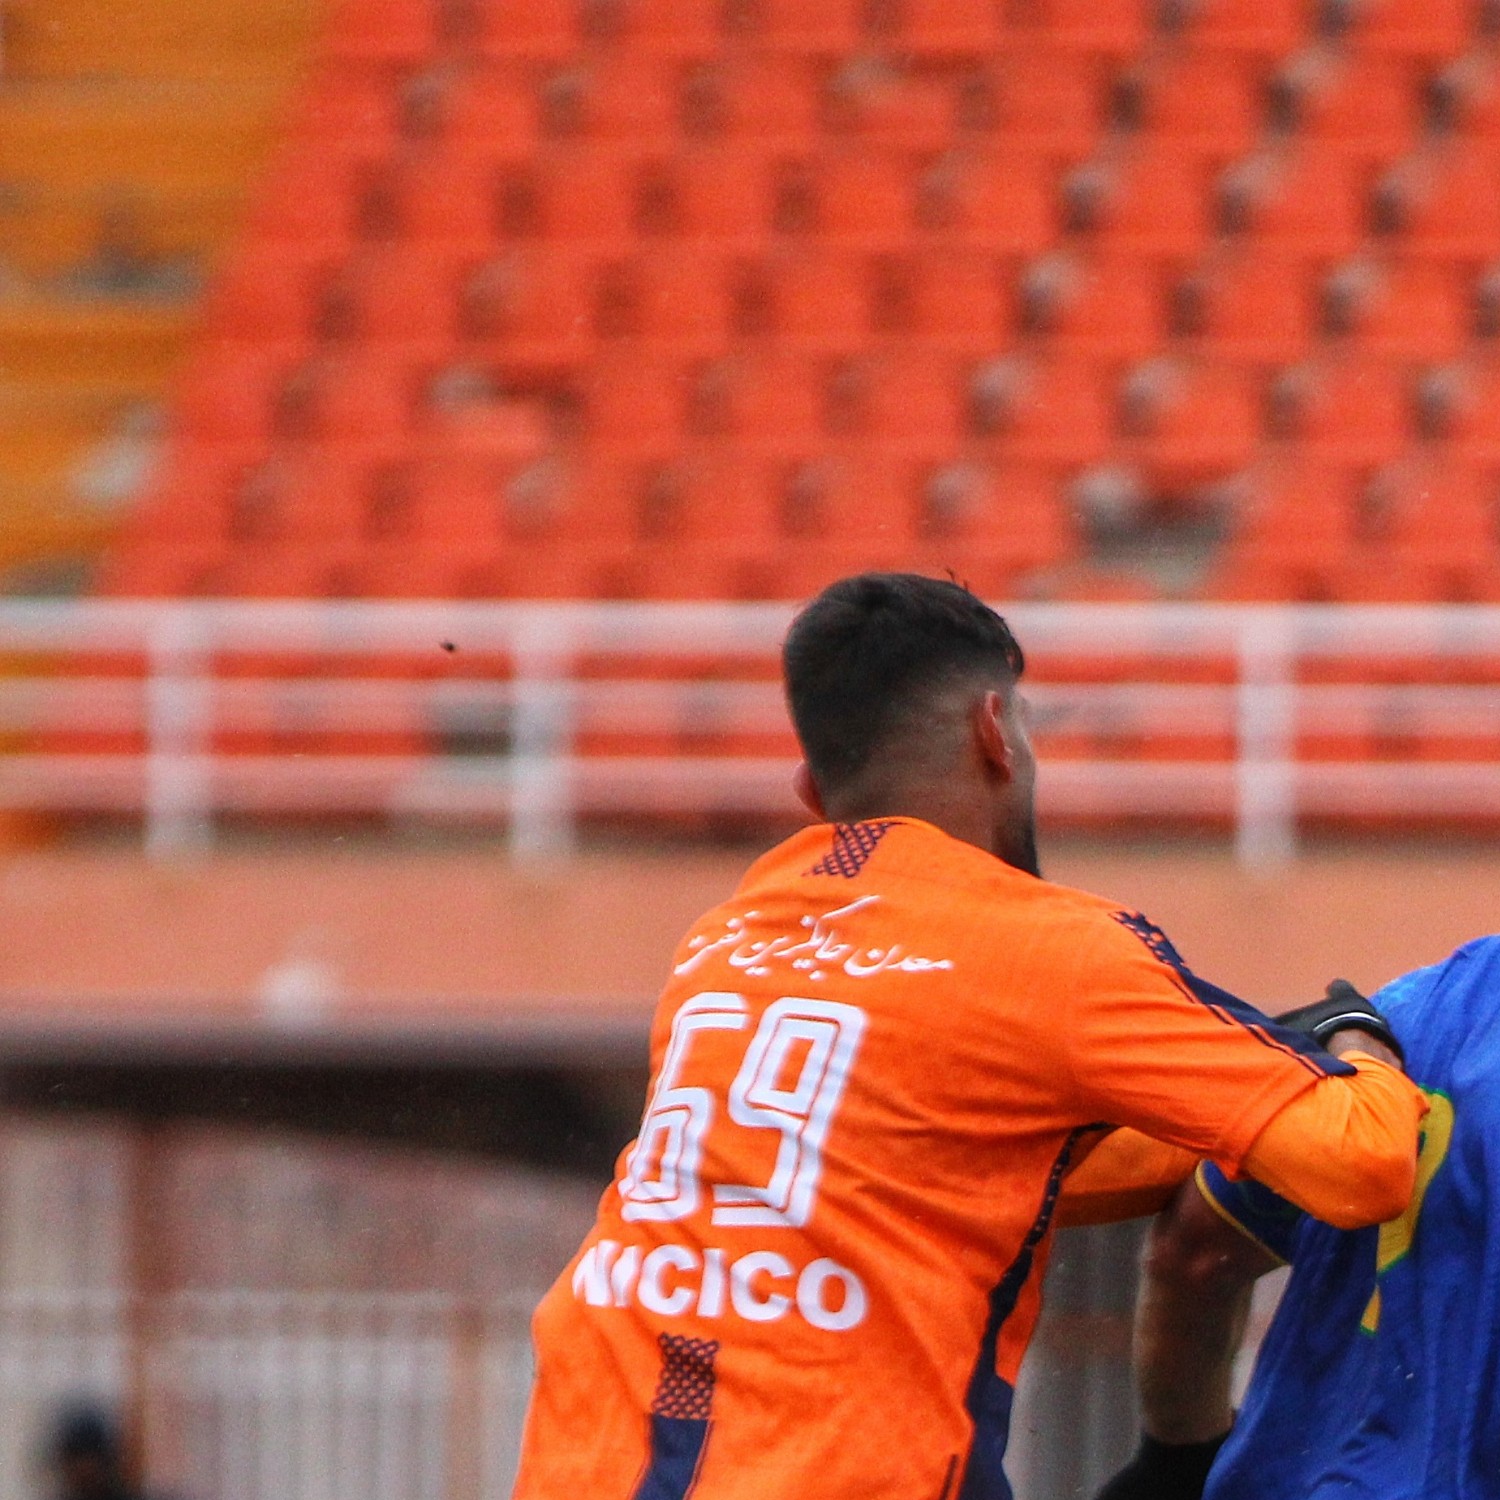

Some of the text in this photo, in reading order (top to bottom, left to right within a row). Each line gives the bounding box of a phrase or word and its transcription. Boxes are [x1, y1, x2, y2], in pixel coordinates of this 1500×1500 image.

[672, 909, 760, 978] نفت
[842, 943, 955, 979] معدن
[616, 990, 870, 1229] 69
[570, 1238, 870, 1332] NICICO
